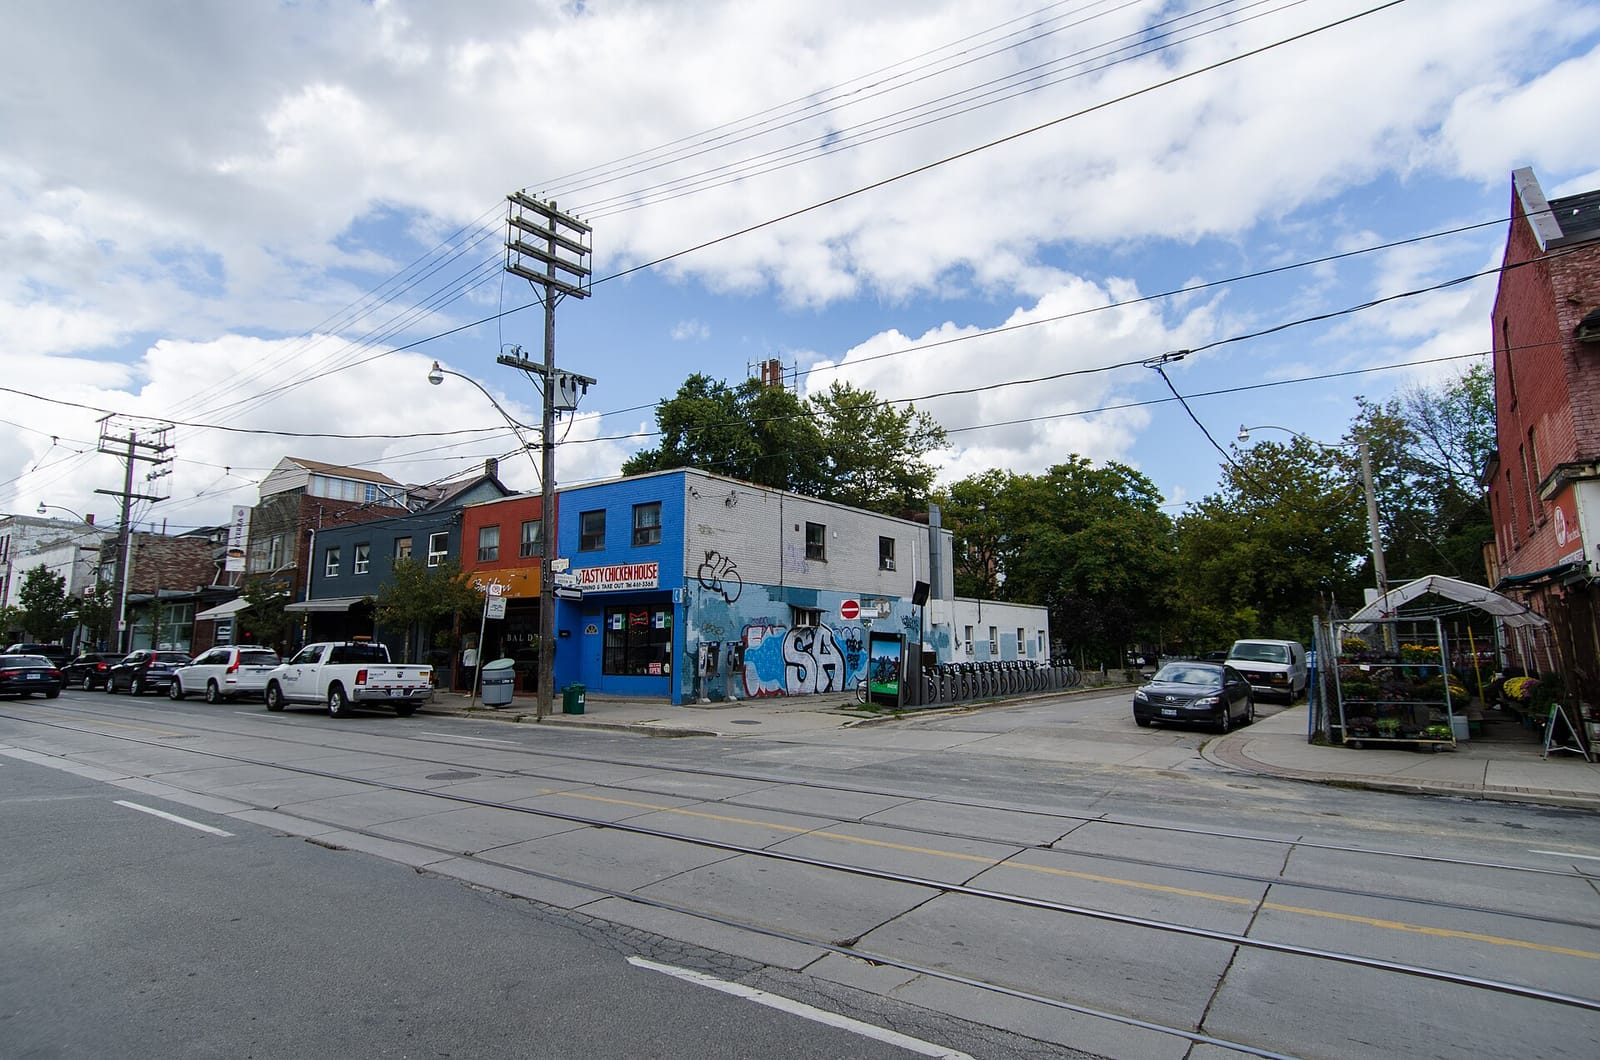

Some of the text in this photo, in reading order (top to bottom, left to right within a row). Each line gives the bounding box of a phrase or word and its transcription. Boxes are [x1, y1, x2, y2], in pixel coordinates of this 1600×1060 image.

[581, 568, 605, 584] TASTY
[605, 565, 633, 582] CHICKEN
[634, 564, 657, 580] HOUSE
